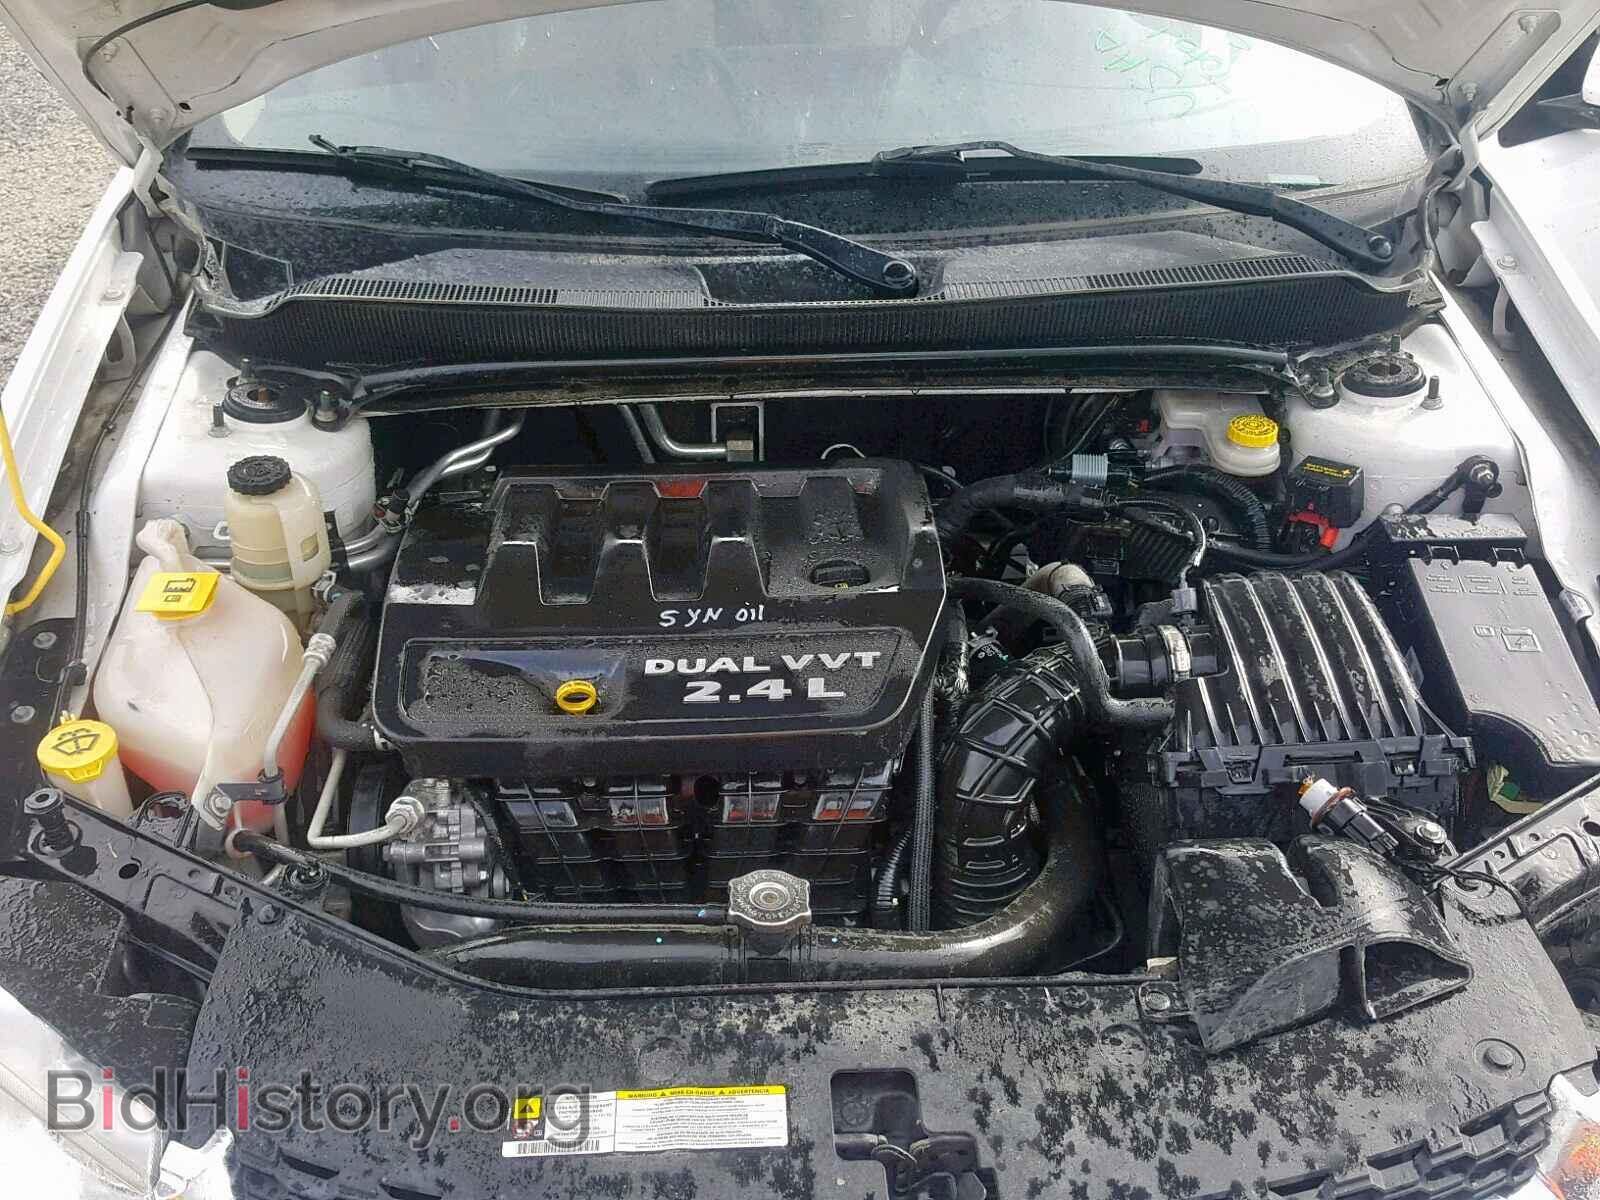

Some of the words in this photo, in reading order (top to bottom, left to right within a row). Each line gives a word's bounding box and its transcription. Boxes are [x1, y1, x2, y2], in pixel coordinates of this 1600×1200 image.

[659, 607, 723, 627] SYN
[644, 656, 771, 675] DUAL
[781, 651, 882, 671] VVT
